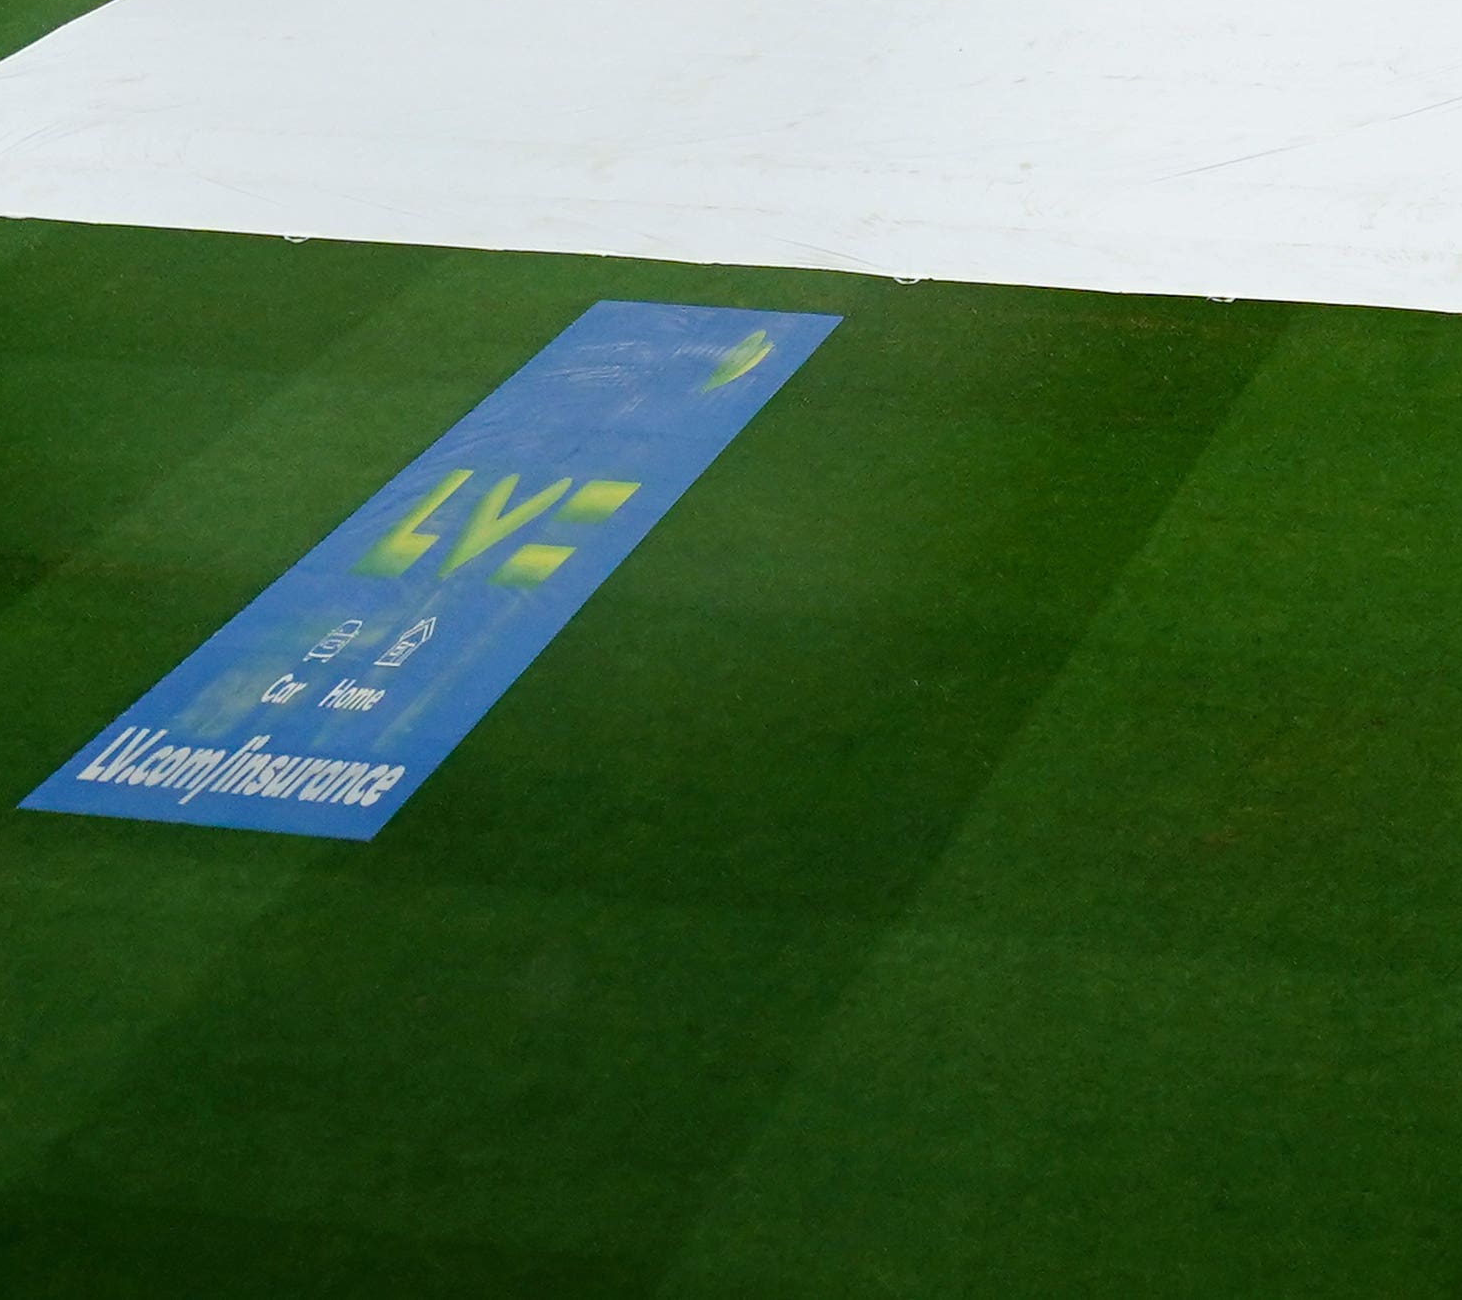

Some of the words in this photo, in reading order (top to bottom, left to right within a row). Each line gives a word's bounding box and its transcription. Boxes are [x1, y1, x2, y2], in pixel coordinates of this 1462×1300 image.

[260, 672, 304, 707] Car
[318, 676, 384, 713] Home
[76, 725, 406, 807] LV.com/insurance
